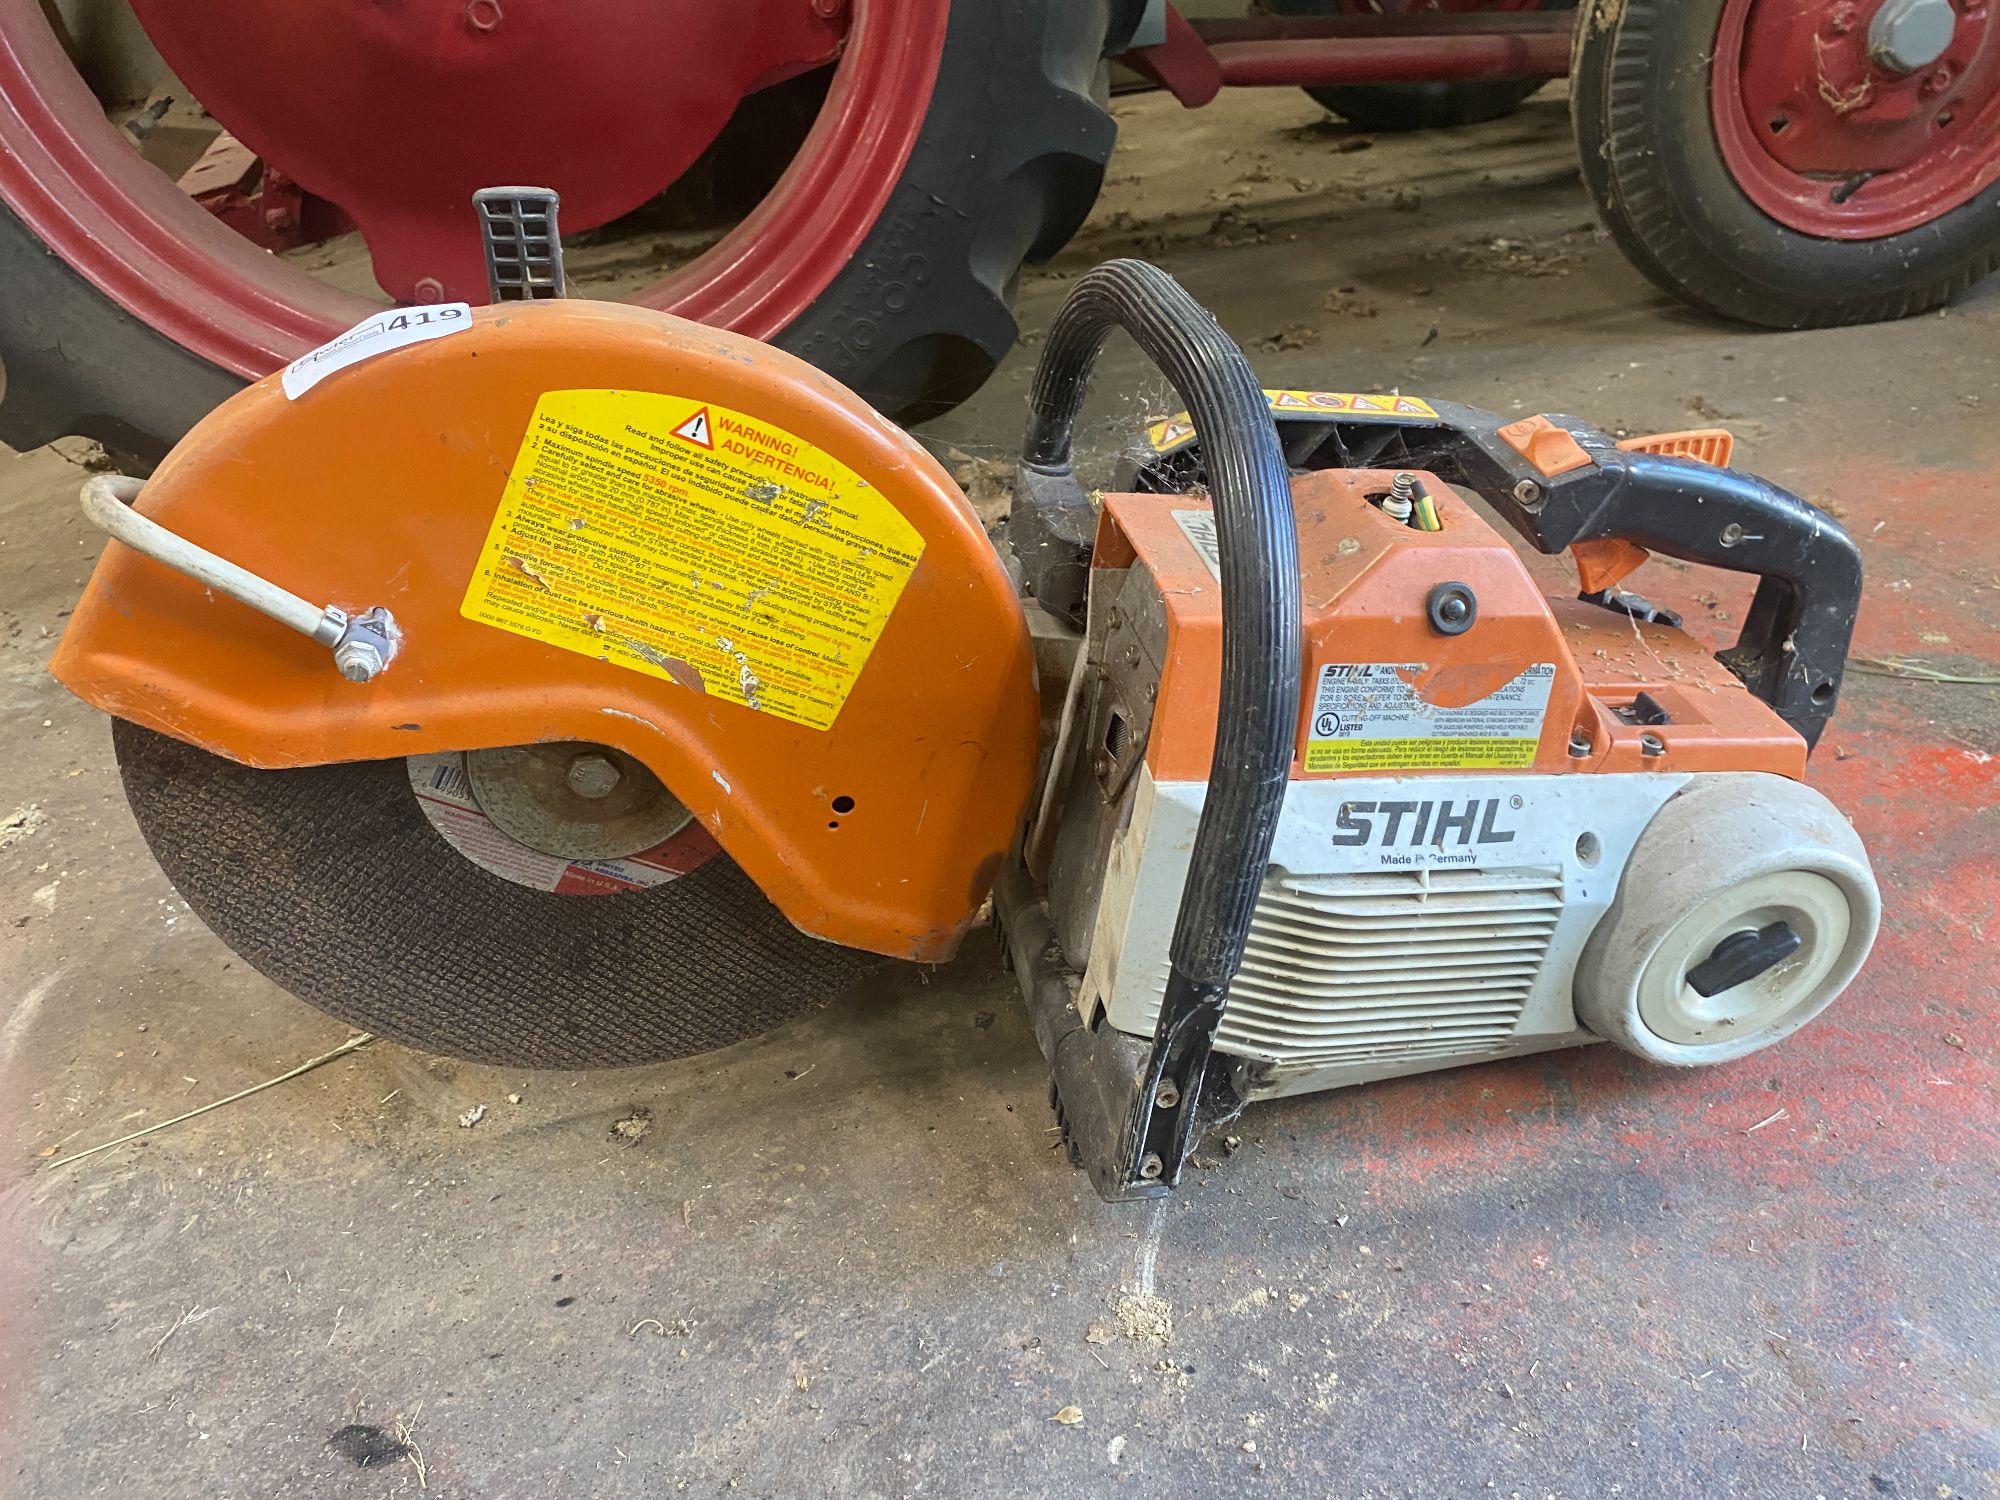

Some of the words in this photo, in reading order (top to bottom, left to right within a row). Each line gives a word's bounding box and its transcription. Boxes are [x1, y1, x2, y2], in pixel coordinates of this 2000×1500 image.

[388, 309, 462, 331] 419
[543, 438, 583, 457] Maximum
[584, 454, 615, 469] spindle
[616, 466, 641, 479] speed
[642, 473, 666, 487] 5350
[718, 416, 798, 457] WARNING!
[539, 412, 555, 424] Lea
[564, 424, 583, 435] siga
[585, 430, 609, 444] todas
[610, 440, 623, 449] las
[624, 447, 680, 471] precauciones
[682, 468, 693, 476] de
[694, 473, 735, 492] seguridad
[833, 525, 884, 551] instrucciones,
[886, 547, 900, 555] que
[559, 430, 609, 453] disposición
[623, 454, 657, 471] español.
[660, 467, 670, 475] El
[670, 472, 686, 482] uso
[687, 477, 723, 495] indebido
[723, 493, 749, 505] puede
[750, 503, 777, 516] causar
[802, 523, 844, 542] personales
[624, 424, 647, 438] Read
[647, 434, 665, 444] and
[665, 440, 691, 454] follow
[703, 456, 729, 470] safety
[729, 466, 776, 489] precauti
[787, 488, 829, 508] instrucn
[830, 505, 858, 520] manual.
[649, 443, 688, 462] Improper
[689, 459, 704, 468] use
[705, 466, 720, 475] can
[722, 472, 746, 485] cause
[788, 496, 806, 508] fatal
[720, 438, 835, 491] ADVERTENCIA!
[531, 441, 538, 449] 2.
[541, 445, 578, 464] Carefully
[579, 459, 605, 473] select
[605, 470, 622, 479] and
[622, 476, 639, 486] care
[641, 482, 653, 490] for
[654, 488, 687, 504] abrasive
[724, 513, 739, 523] Use
[740, 520, 756, 530] only
[756, 526, 781, 539] wheels
[808, 546, 822, 554] with
[872, 569, 893, 581] speed
[509, 527, 537, 540] Adjust
[538, 536, 551, 545] the
[552, 542, 577, 554] guard
[514, 514, 544, 528] Always
[547, 525, 566, 535] wear
[566, 532, 607, 549] protective
[608, 547, 640, 563] clothing
[493, 572, 532, 590] Inhalation
[543, 589, 561, 599] dust
[578, 599, 588, 607] be
[595, 606, 623, 619] serious
[624, 615, 648, 627] health
[649, 623, 676, 636] hazard.
[503, 546, 537, 562] Reactive
[729, 623, 746, 633] may
[746, 629, 768, 640] cause
[769, 636, 784, 645] loss
[1332, 799, 1516, 847] STIHL
[1381, 855, 1411, 865] Made
